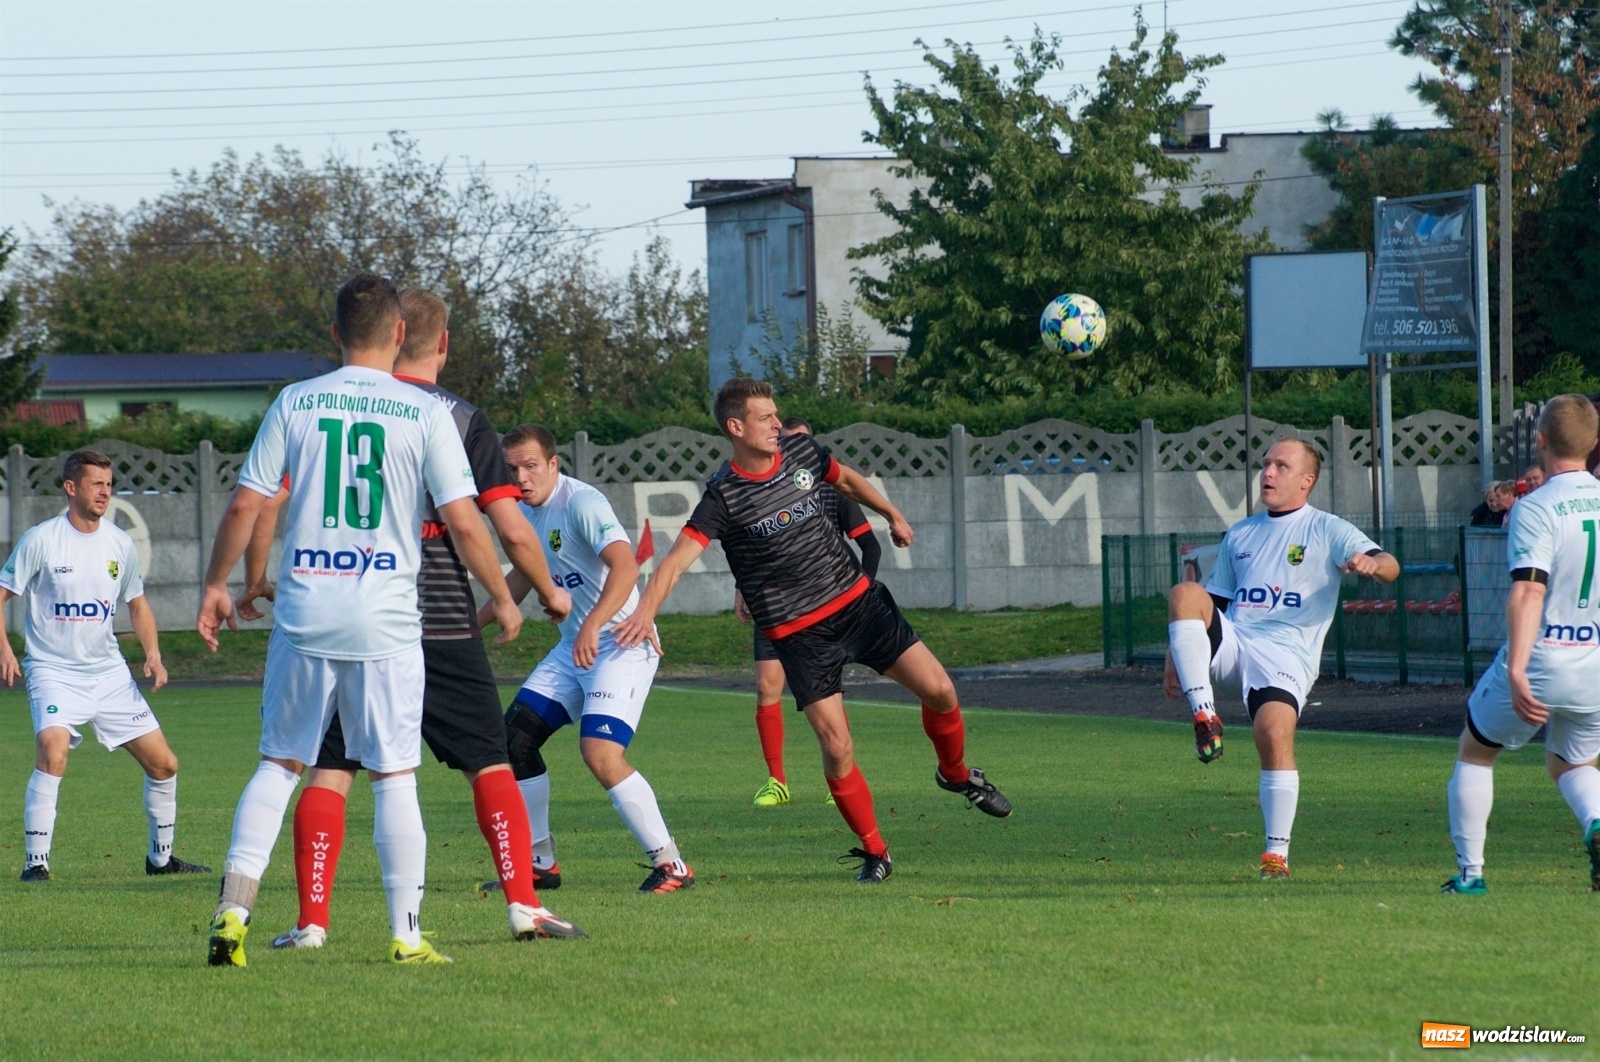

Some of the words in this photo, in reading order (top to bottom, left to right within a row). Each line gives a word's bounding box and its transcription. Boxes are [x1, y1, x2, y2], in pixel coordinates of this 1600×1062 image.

[1374, 320, 1389, 335] tel.
[1392, 319, 1414, 335] 506
[1415, 320, 1438, 335] 501
[1439, 318, 1458, 335] 396
[293, 394, 314, 412] LKS
[317, 392, 367, 413] POLONIA
[371, 398, 420, 422] ŁAZISKA
[318, 418, 385, 530] 13
[293, 544, 396, 580] moya
[312, 569, 336, 577] stacji
[586, 689, 614, 700] moya
[491, 811, 516, 881] TWORKÓW
[310, 832, 330, 904] TWORKÓW
